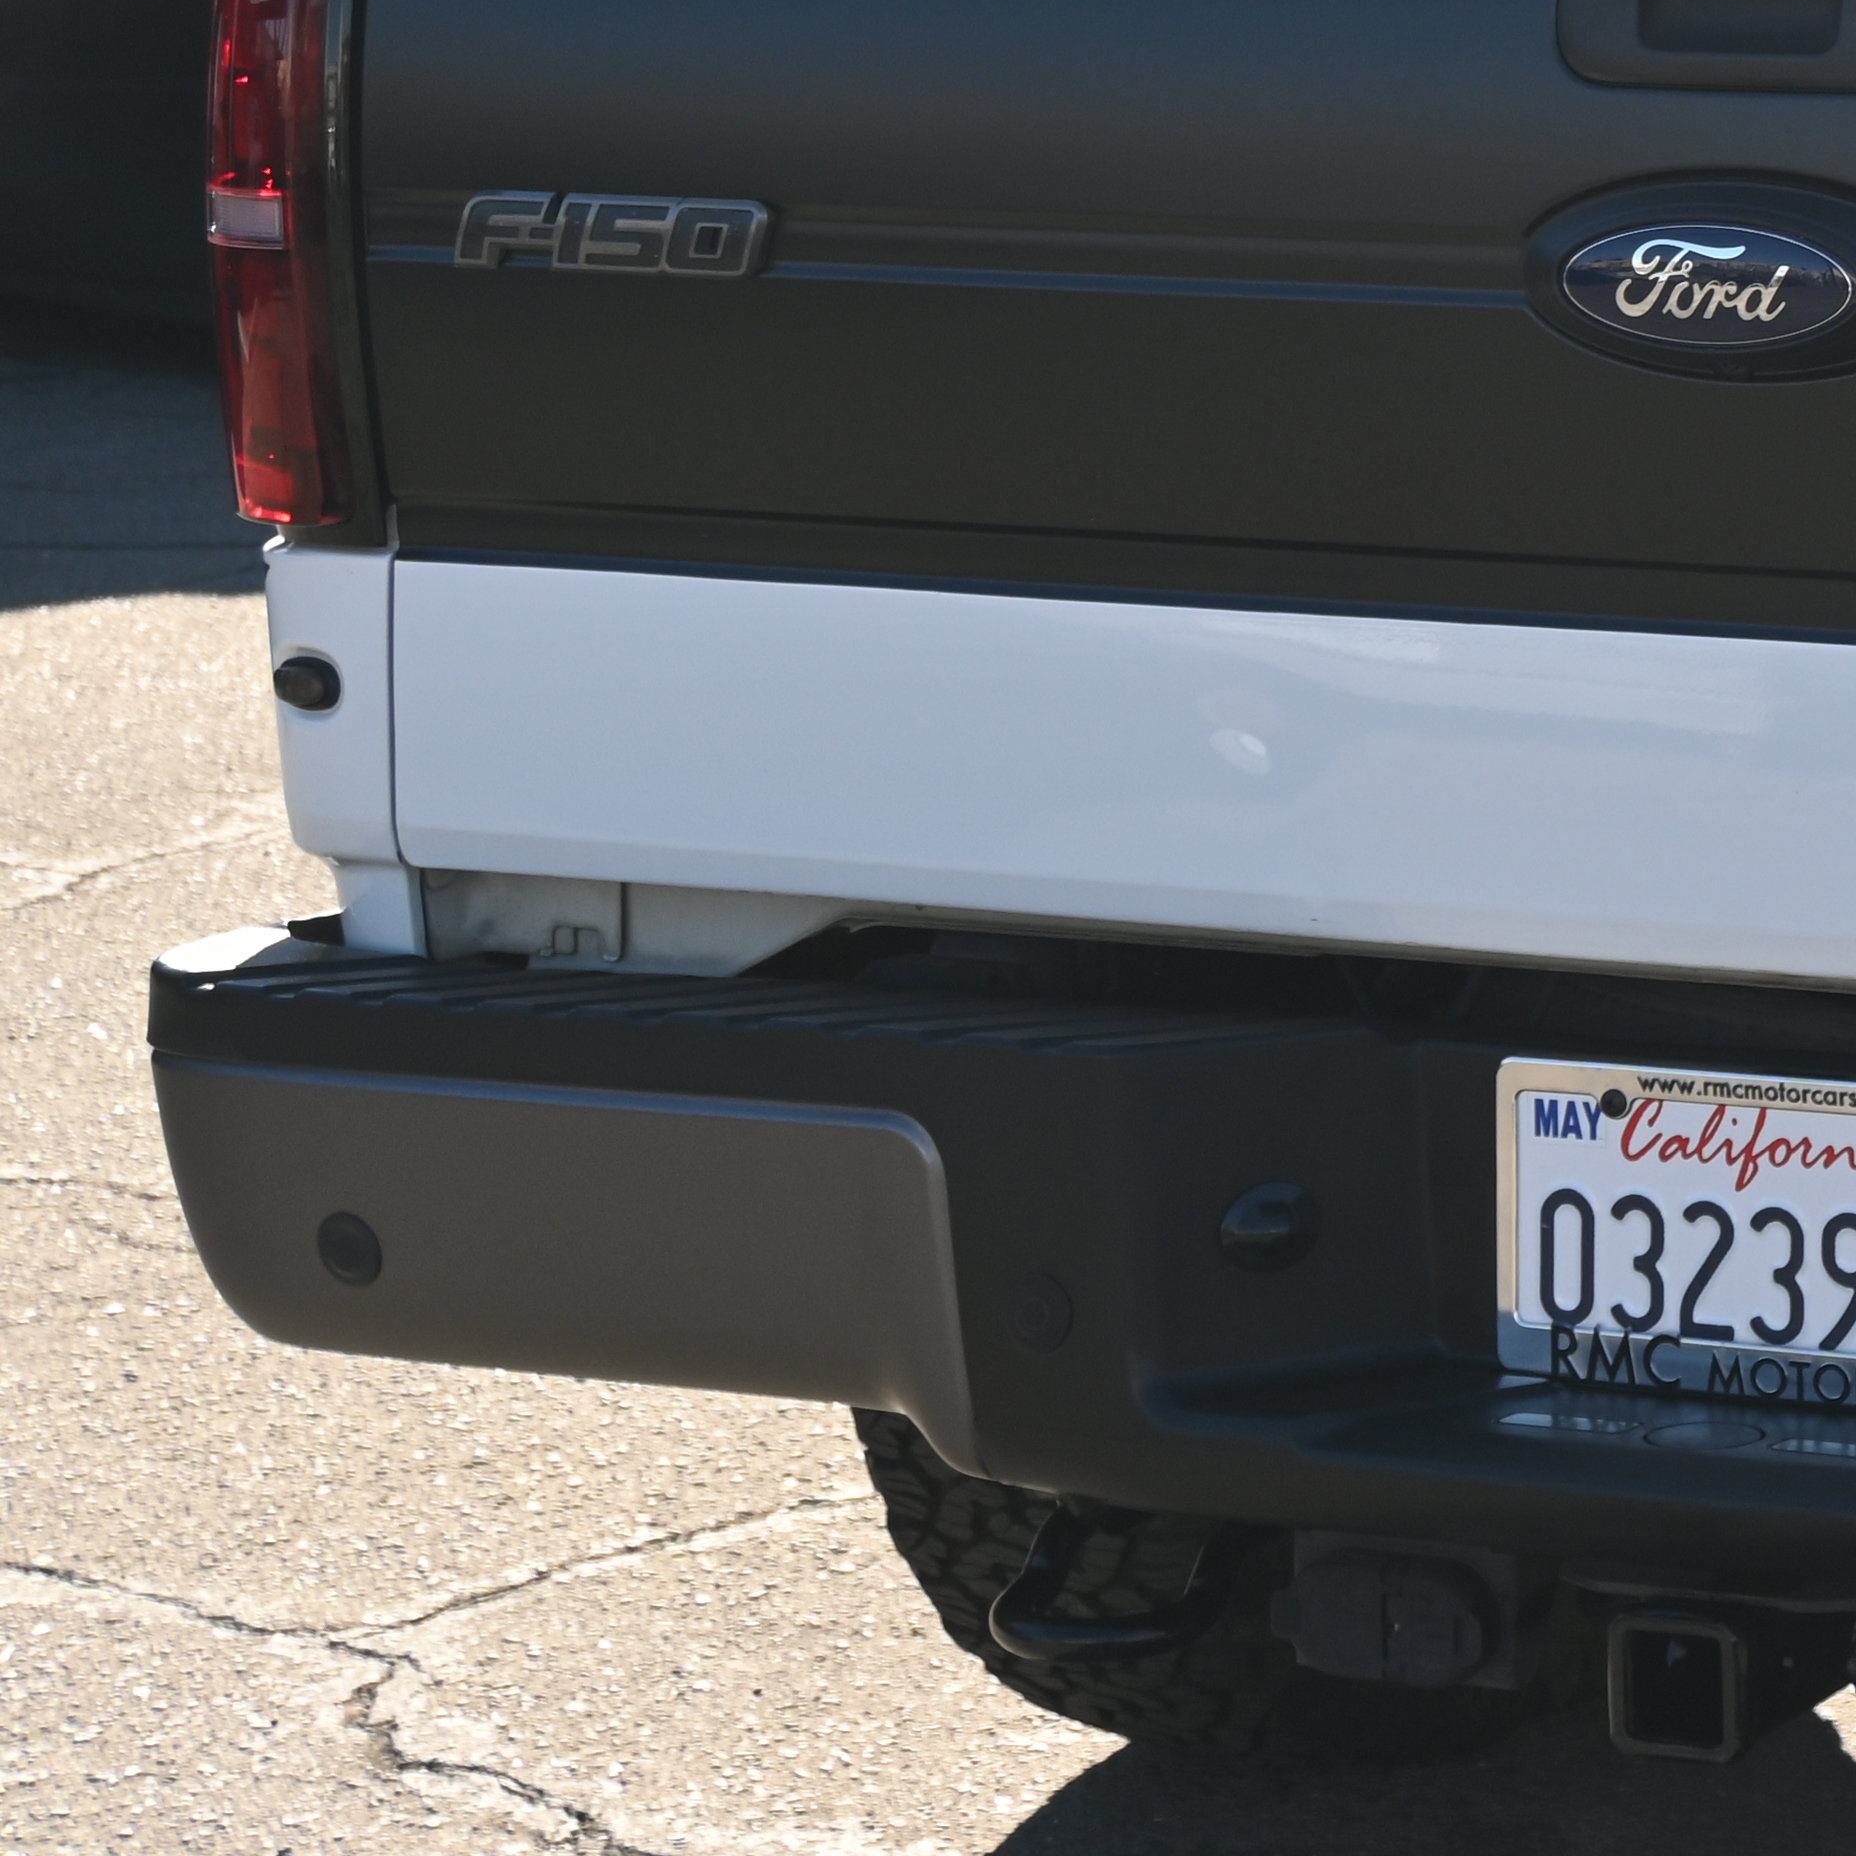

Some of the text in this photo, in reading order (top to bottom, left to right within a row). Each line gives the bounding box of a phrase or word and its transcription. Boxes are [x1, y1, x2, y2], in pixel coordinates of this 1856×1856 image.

[454, 190, 770, 277] F-150
[1615, 239, 1790, 322] Ford
[1534, 1098, 1602, 1141] MAY
[1551, 1324, 1683, 1387] RMC
